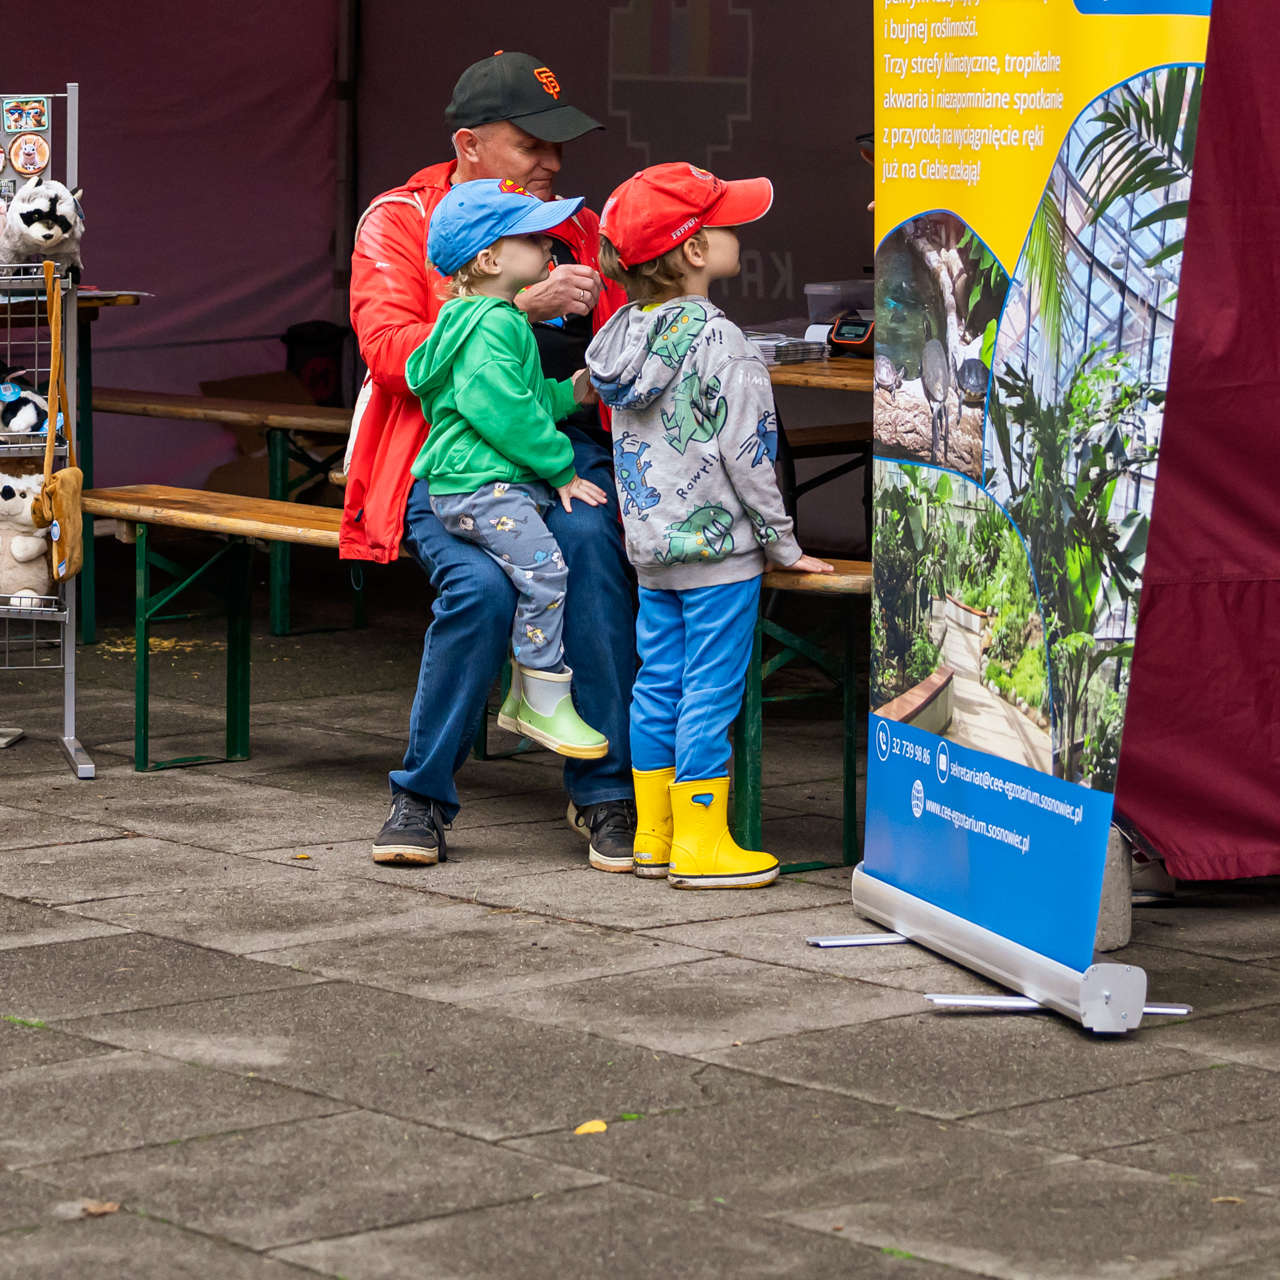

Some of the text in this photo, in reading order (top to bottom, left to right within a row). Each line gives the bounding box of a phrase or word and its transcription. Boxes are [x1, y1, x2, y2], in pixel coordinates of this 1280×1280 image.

[884, 16, 978, 44] i bujnej roślinności.
[884, 51, 1061, 79] Trzy strefy klimatyczne, tropikalne
[884, 88, 1063, 114] akwaria i niezapomniane spotkanie
[883, 124, 1044, 151] z przyrodą na wyciągnięcie ręki
[882, 158, 981, 186] już na Ciebie czekają!
[671, 216, 699, 240] Ferrari
[676, 453, 719, 500] Rawr!!
[892, 737, 931, 765] 32 739 98 86
[950, 761, 1083, 825] sekretariat@cee-egzotarium.sosnowiec.pl
[925, 798, 1030, 855] www.cee-egzotarium.sosnowiec.pl
